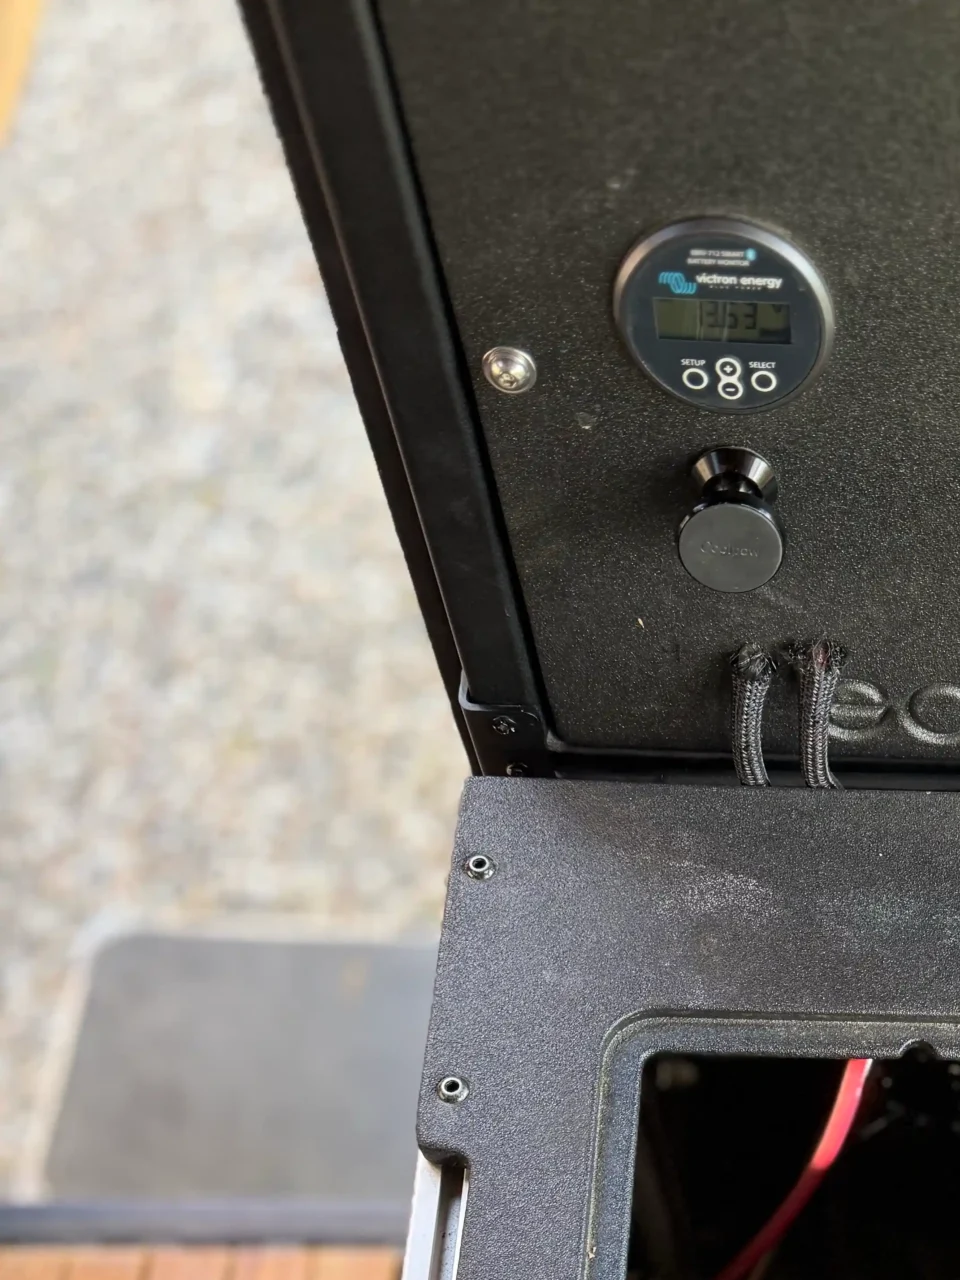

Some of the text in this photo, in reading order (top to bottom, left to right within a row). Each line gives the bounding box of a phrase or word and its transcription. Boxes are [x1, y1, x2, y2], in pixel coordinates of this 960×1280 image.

[695, 273, 783, 289] victron energy
[680, 358, 706, 367] SETUP
[748, 361, 777, 369] SELECT
